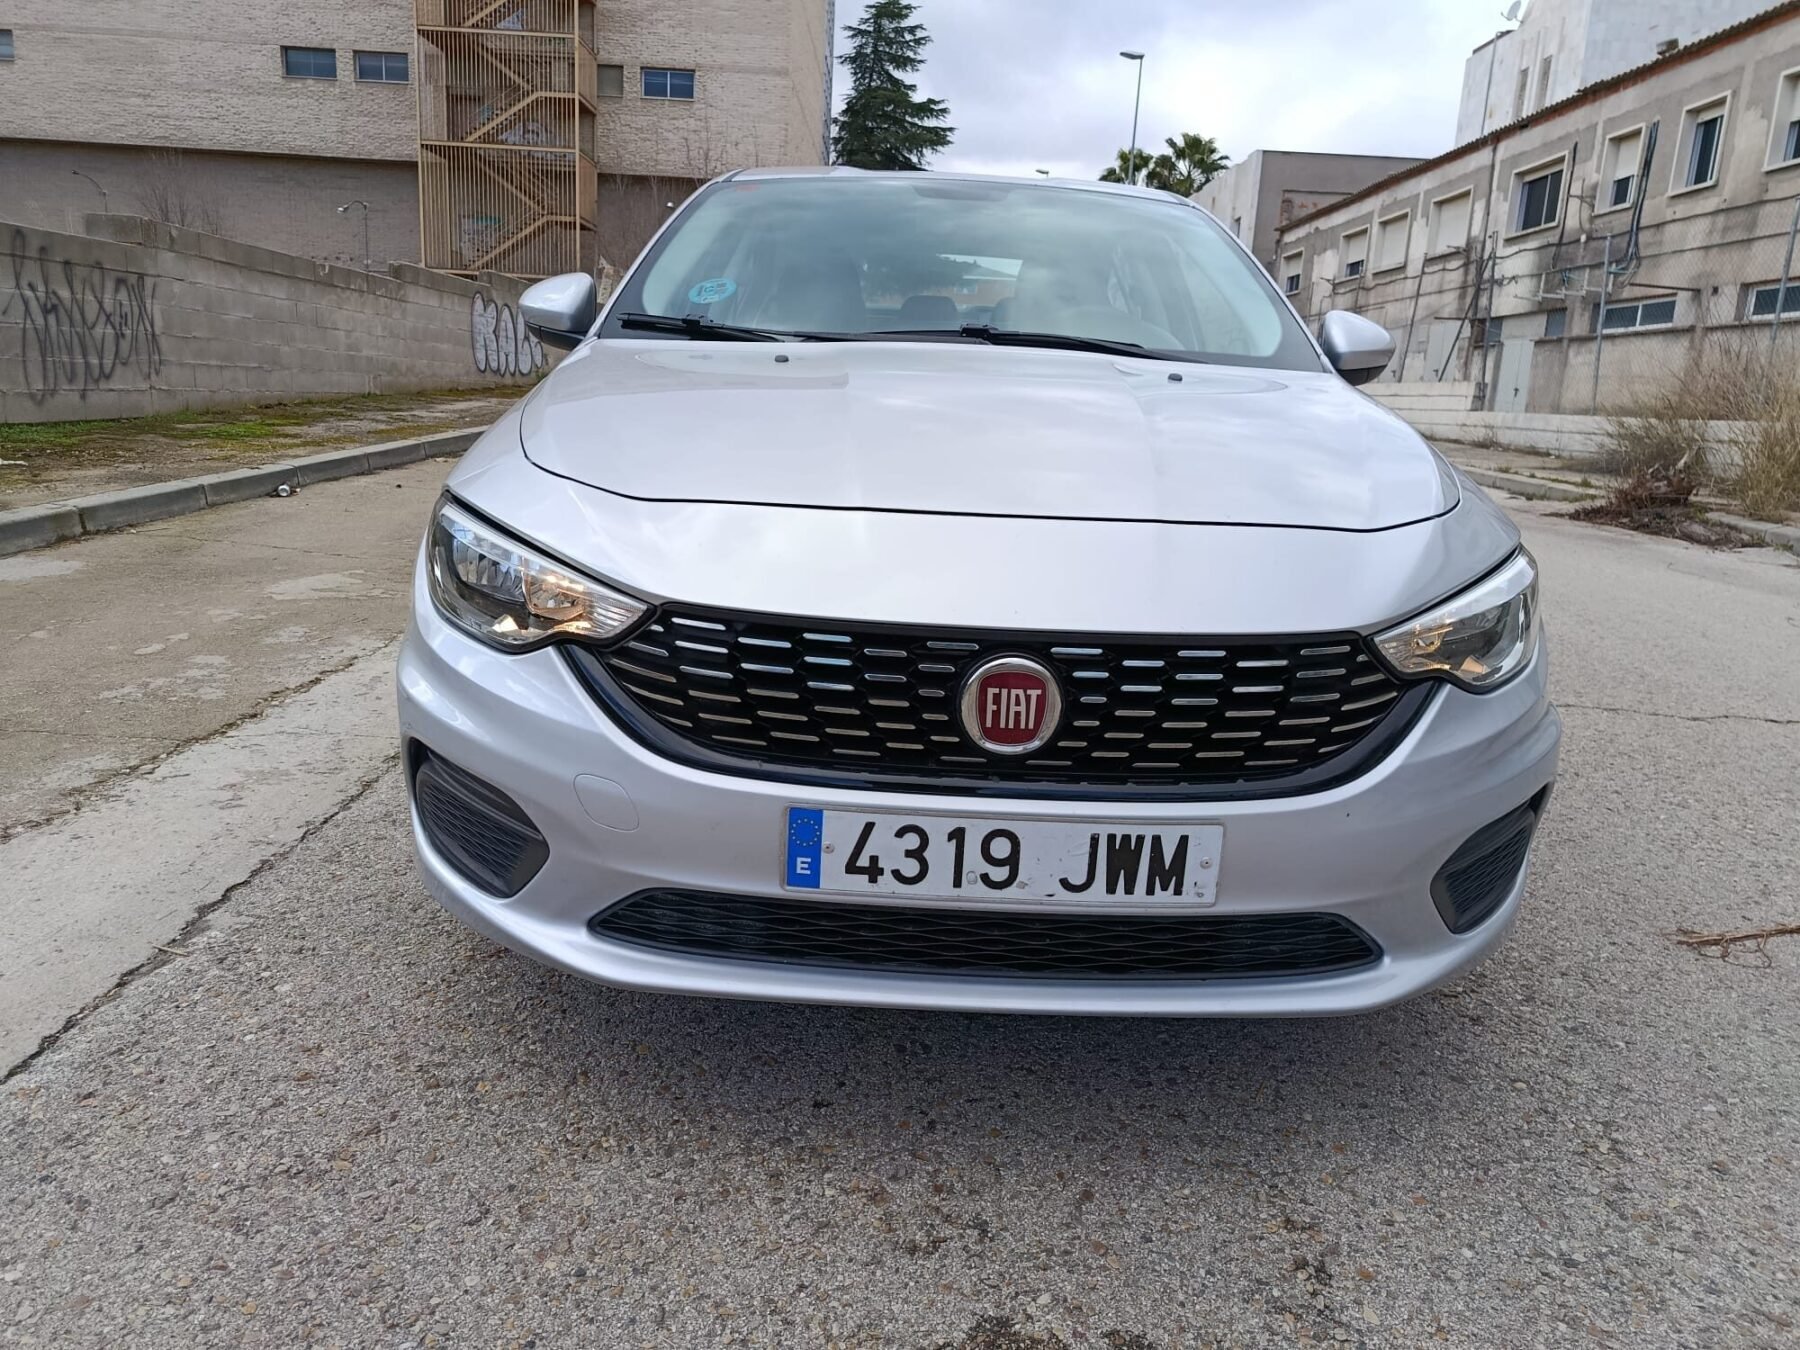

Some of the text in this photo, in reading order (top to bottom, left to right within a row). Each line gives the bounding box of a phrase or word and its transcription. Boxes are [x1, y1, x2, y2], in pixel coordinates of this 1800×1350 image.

[985, 687, 1042, 729] FIAT
[796, 821, 1190, 897] E 4319 JWM
